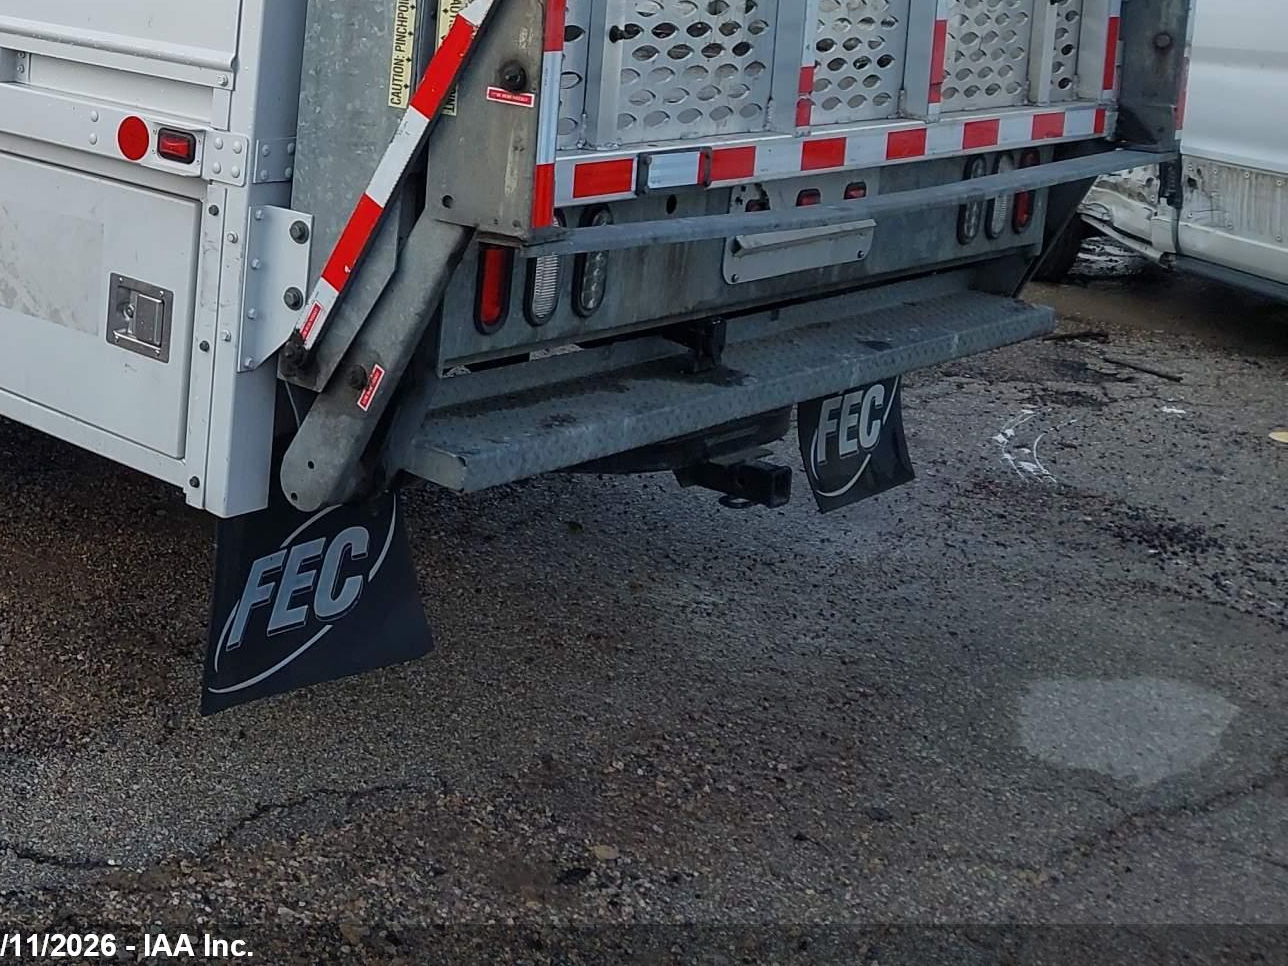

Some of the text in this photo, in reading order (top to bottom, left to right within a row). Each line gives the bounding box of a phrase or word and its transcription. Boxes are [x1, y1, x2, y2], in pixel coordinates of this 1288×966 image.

[390, 55, 405, 106] CAUTION:
[817, 384, 885, 467] FEC
[226, 525, 370, 652] FEC
